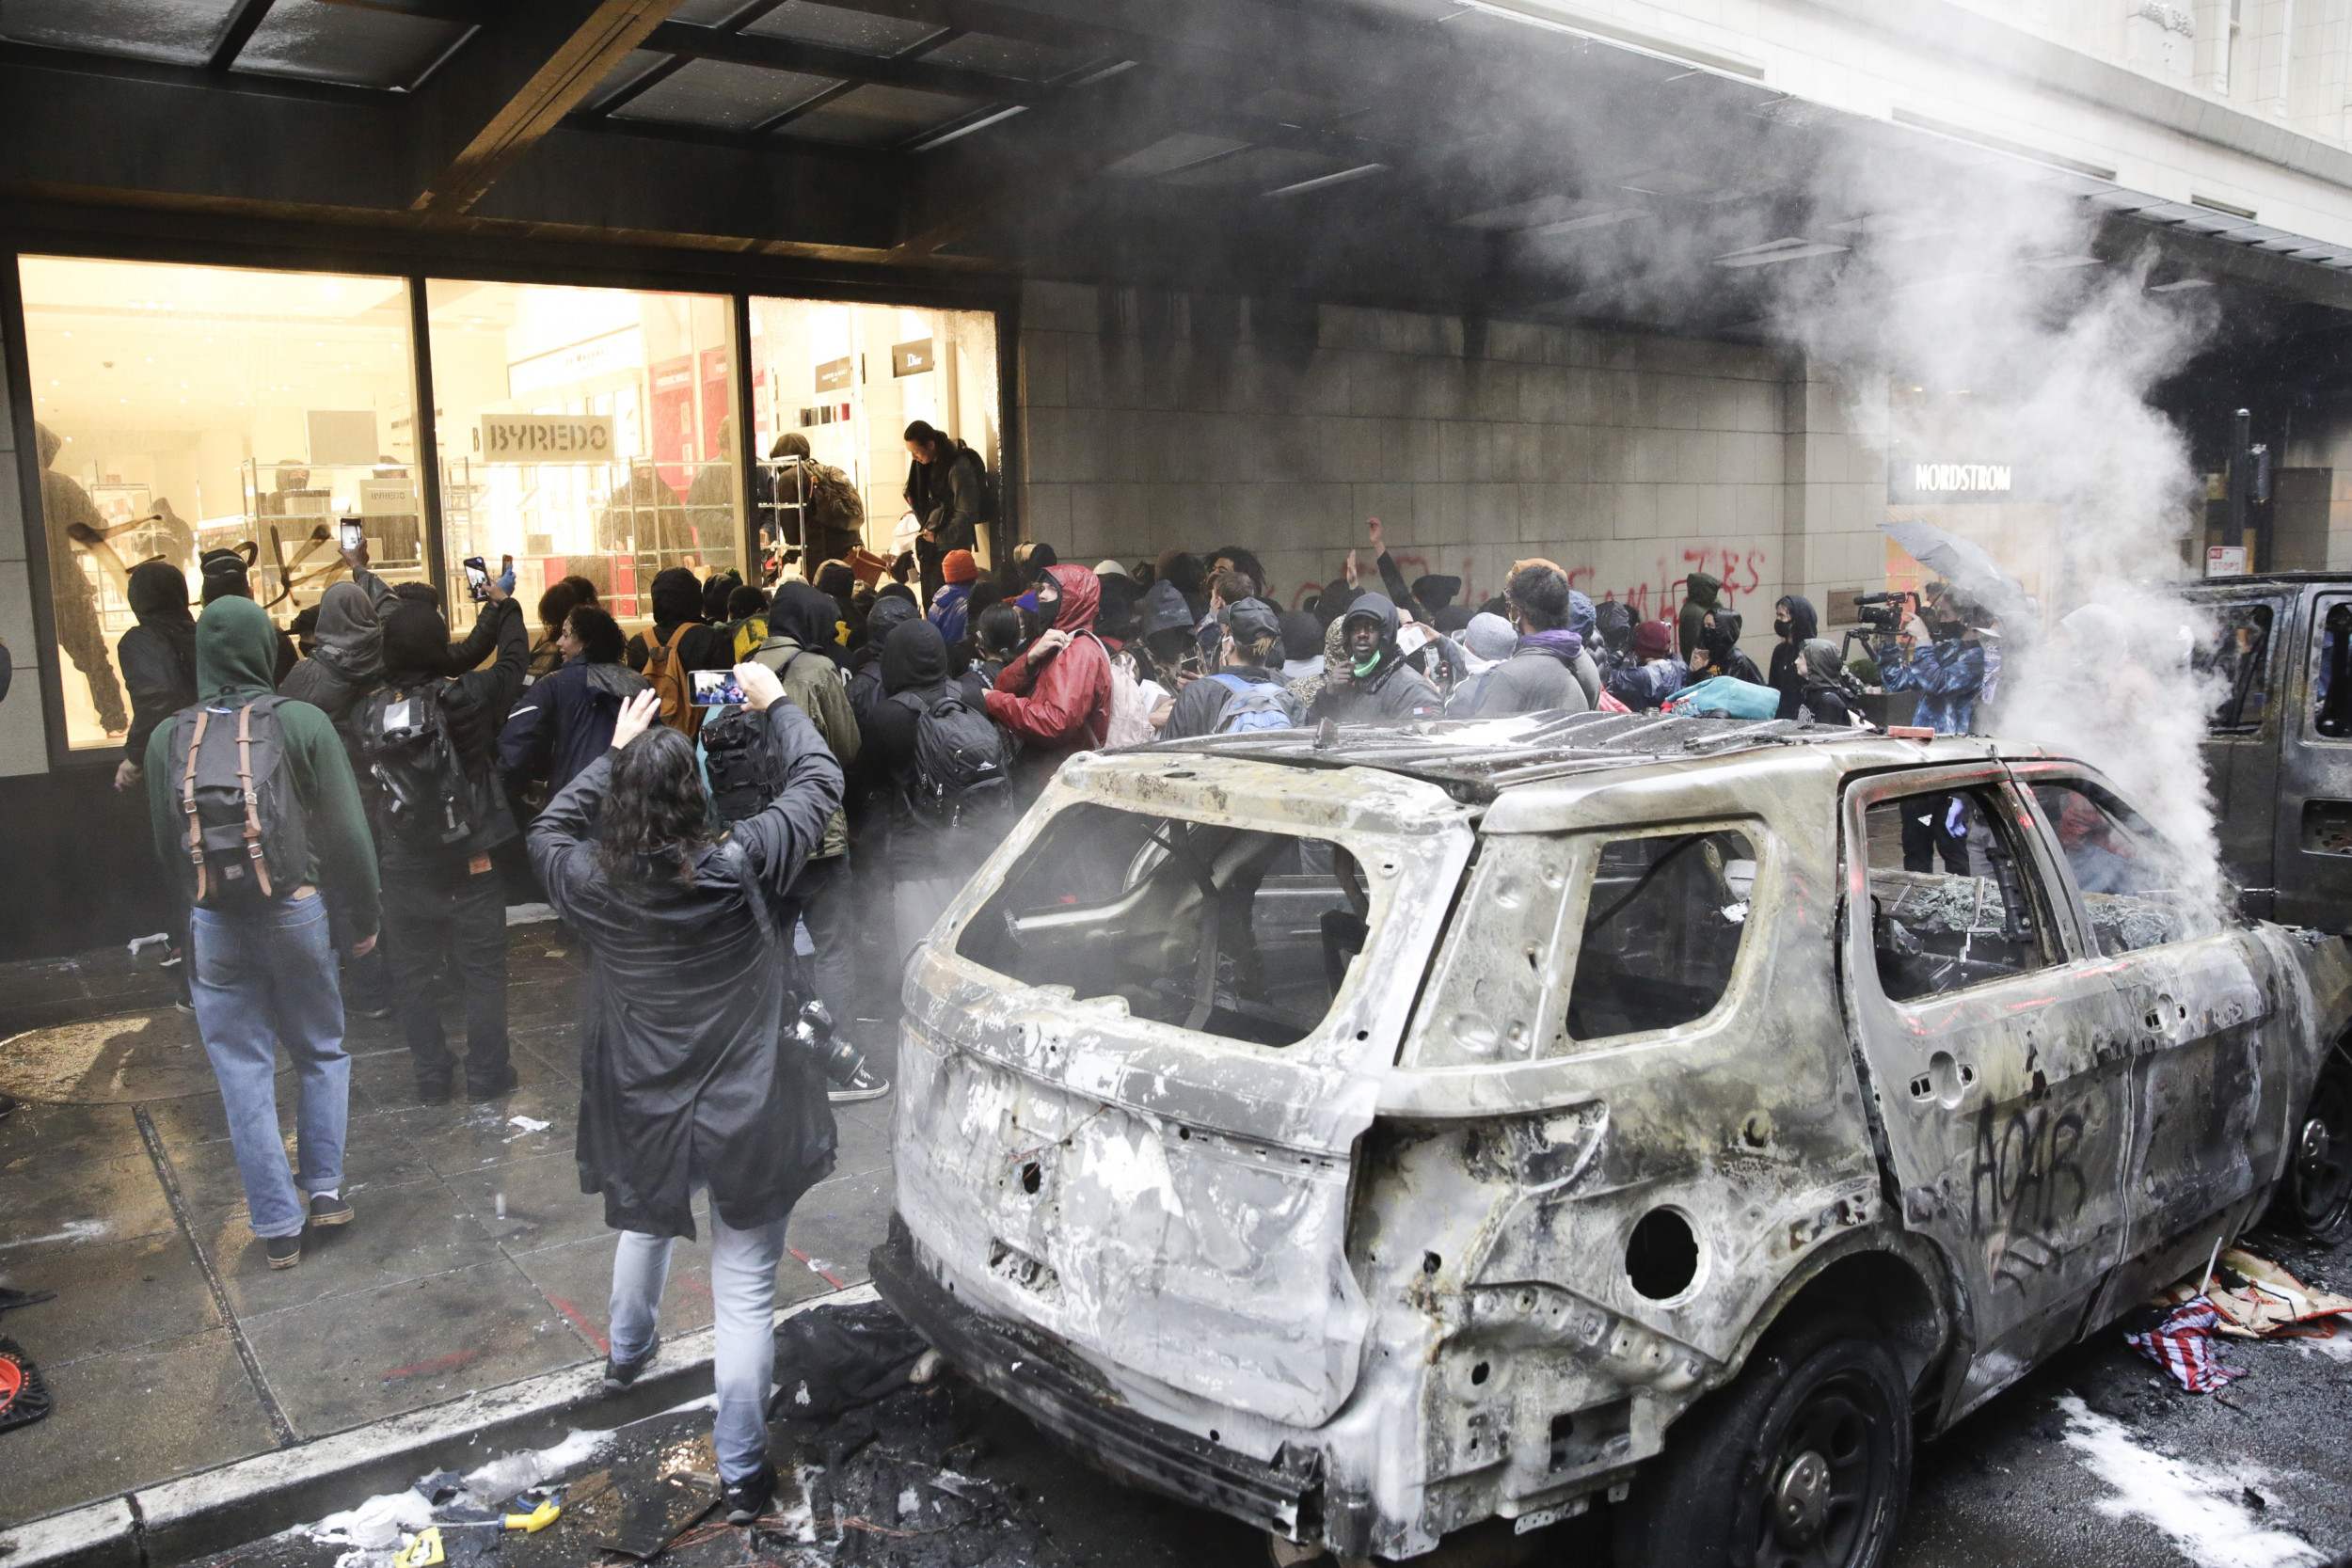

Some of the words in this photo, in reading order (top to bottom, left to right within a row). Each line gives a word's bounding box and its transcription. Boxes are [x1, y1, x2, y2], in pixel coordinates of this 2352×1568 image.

[907, 353, 922, 367] Dior
[489, 424, 608, 451] BYREDO
[1915, 464, 2010, 490] NORDSTROM
[371, 491, 405, 500] BYREDO
